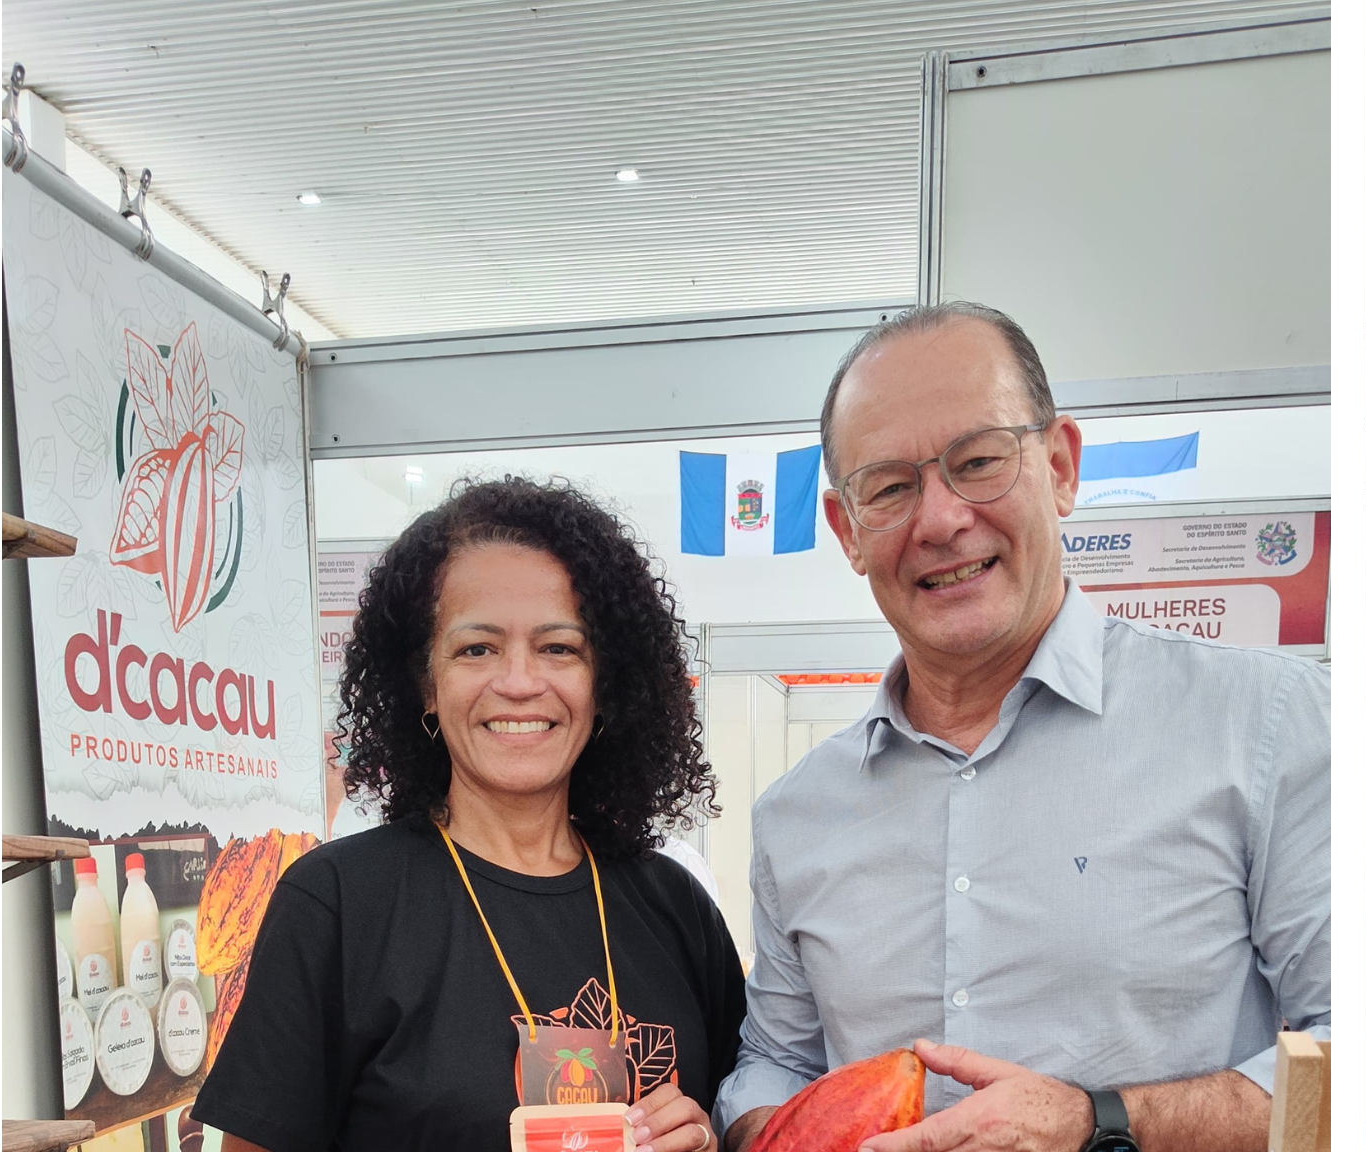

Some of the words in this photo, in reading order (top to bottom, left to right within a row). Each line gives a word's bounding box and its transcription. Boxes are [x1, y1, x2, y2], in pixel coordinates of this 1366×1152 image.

[1183, 523, 1212, 531] GOVERNO
[1213, 522, 1223, 530] DO
[1224, 521, 1248, 530] ESTADO
[1187, 531, 1196, 539] DO
[1197, 529, 1225, 538] ESPÍRITO
[1226, 529, 1247, 537] SANTO
[1106, 597, 1226, 620] MULHERES
[70, 733, 179, 769] PRODUTOS
[184, 747, 279, 780] ARTESANAIS
[556, 1086, 598, 1105] CACAU
